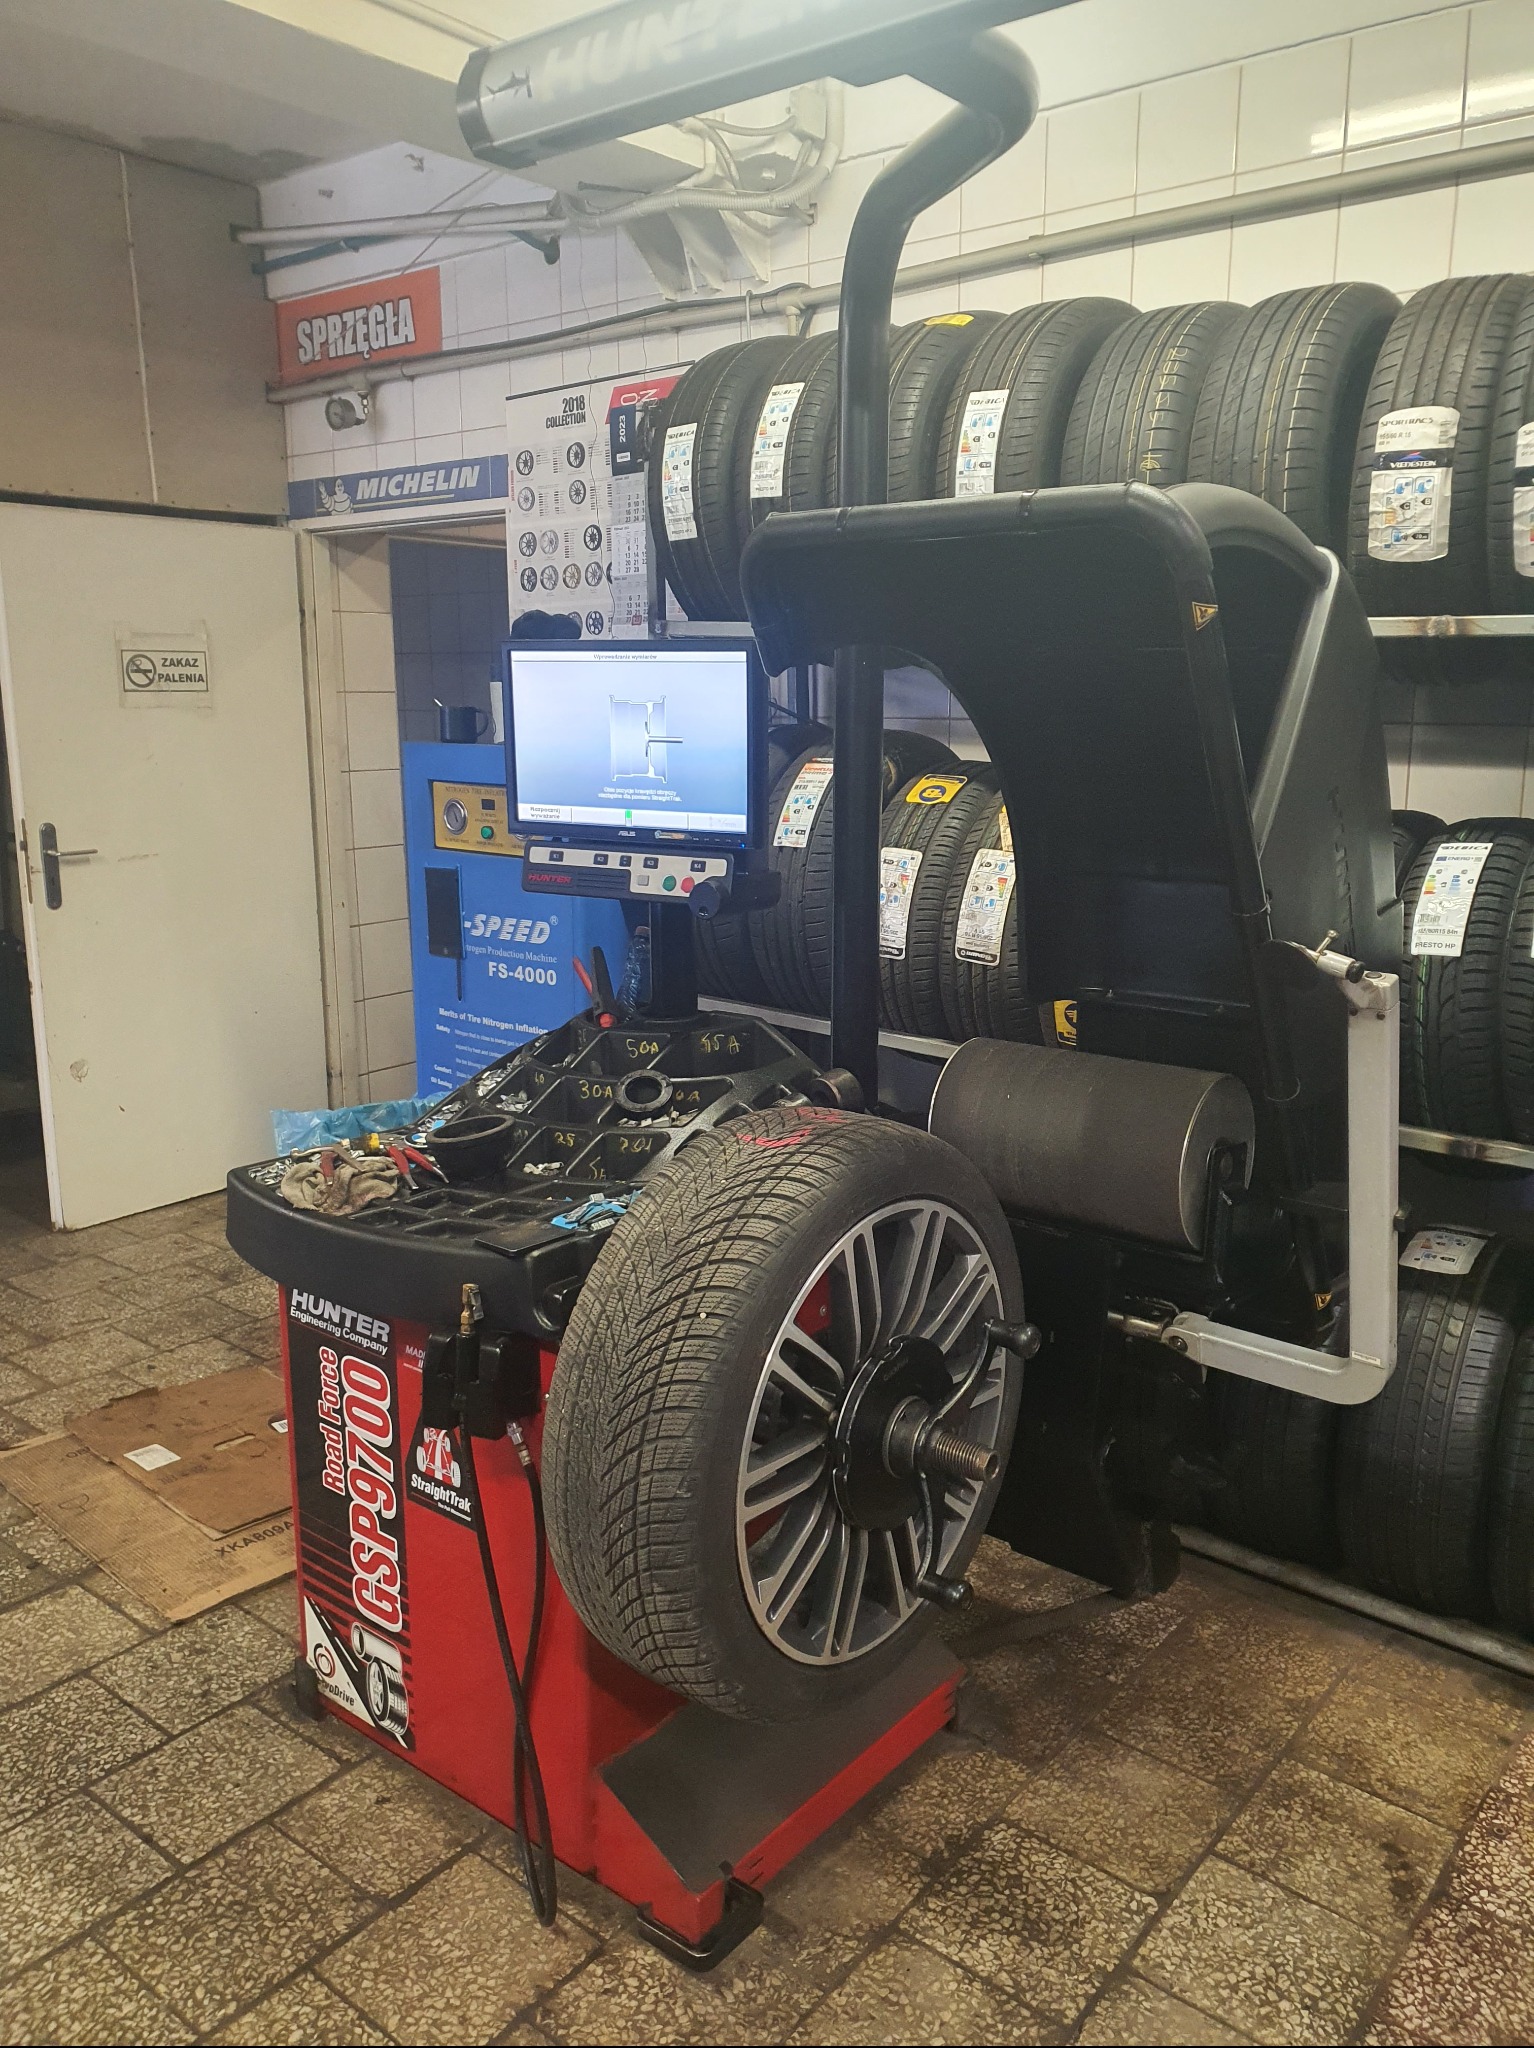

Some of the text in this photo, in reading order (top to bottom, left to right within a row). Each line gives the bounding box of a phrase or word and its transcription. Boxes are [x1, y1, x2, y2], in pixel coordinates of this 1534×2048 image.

[537, 0, 846, 102] HUNTE
[297, 297, 416, 365] SPRZĘGŁA
[562, 394, 586, 414] 2018
[545, 410, 587, 429] COLLECTION
[356, 465, 480, 500] MICHELIN
[161, 657, 199, 668] ZAKAZ
[157, 673, 205, 683] PALENIA
[527, 873, 573, 885] HUNTER
[488, 946, 524, 960] Production
[525, 952, 558, 963] Machine
[487, 961, 557, 986] FS-4000
[438, 1007, 459, 1020] Merits
[459, 1010, 466, 1020] of
[467, 1012, 481, 1024] Tire
[482, 1016, 514, 1031] Nitrogen
[626, 1038, 659, 1058] 50A
[578, 1080, 613, 1099] 30A
[291, 1288, 391, 1342] HUNTER
[290, 1306, 389, 1356] Engineering Company
[317, 1345, 346, 1496] Road Force
[340, 1355, 403, 1633] GSP9700
[411, 1473, 472, 1513] StraightTrak
[214, 1520, 294, 1558] XKA809A
